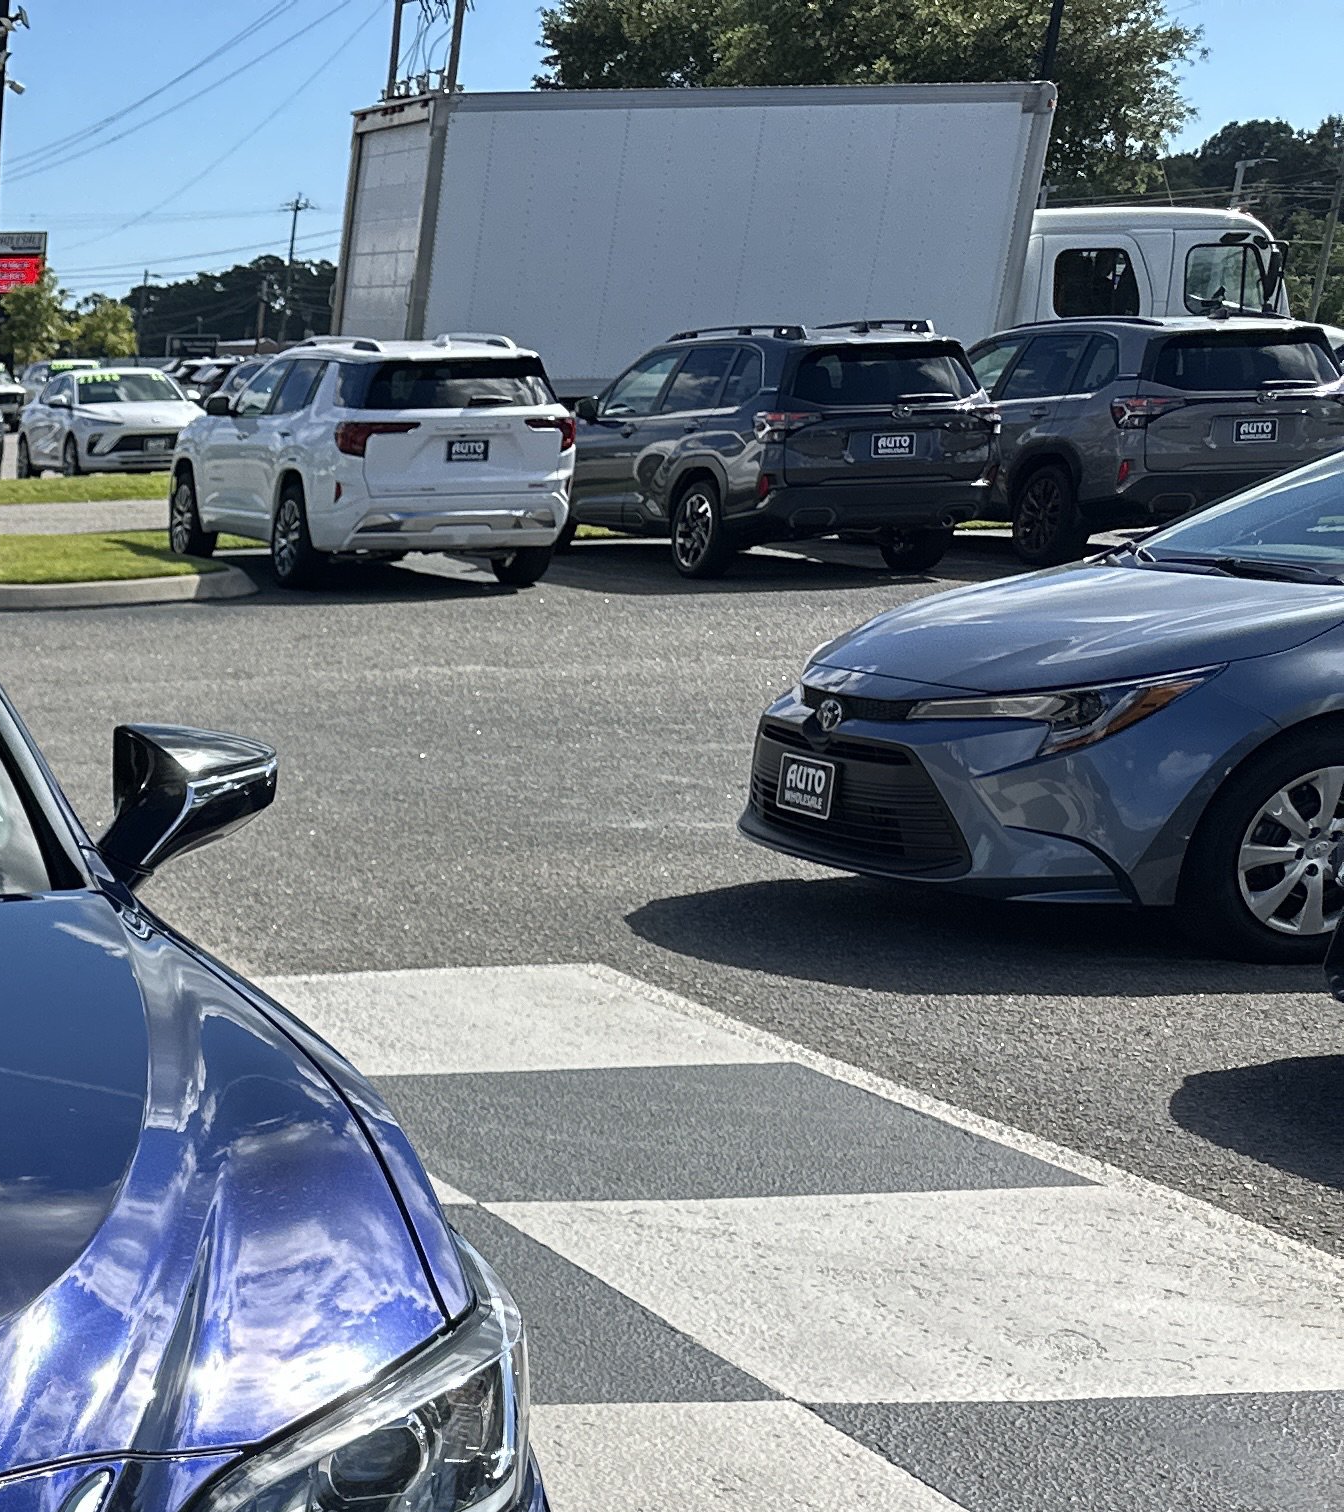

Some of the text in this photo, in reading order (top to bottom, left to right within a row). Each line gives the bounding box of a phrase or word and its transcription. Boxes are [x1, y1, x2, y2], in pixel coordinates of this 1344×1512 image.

[1240, 421, 1272, 434] AUTO
[452, 441, 484, 454] AUTO
[878, 436, 910, 449] AUTO
[786, 763, 826, 794] AUTO
[784, 789, 823, 810] WHOLESALE
